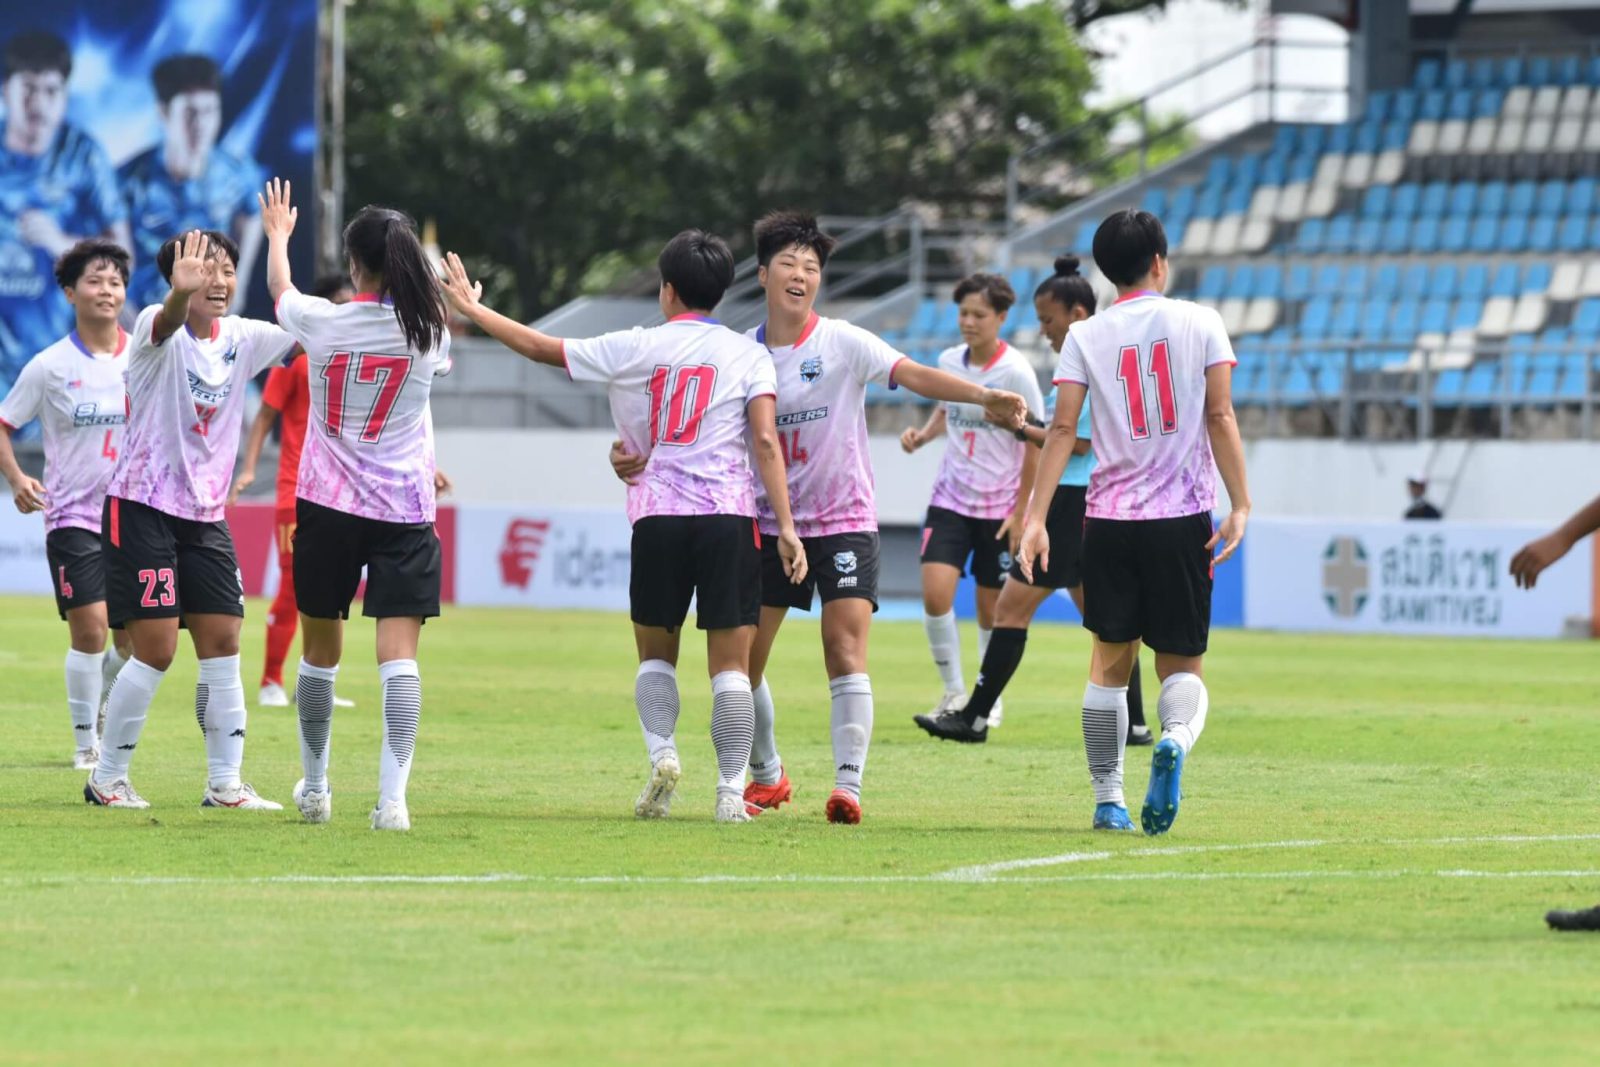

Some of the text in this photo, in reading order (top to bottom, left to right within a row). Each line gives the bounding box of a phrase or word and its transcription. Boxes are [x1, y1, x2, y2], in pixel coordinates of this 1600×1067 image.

[320, 350, 413, 444] 17
[645, 363, 719, 447] 10
[1117, 338, 1178, 440] 11
[775, 406, 828, 427] CHERS
[102, 427, 118, 463] 4
[962, 431, 976, 459] 7
[138, 568, 177, 608] 23
